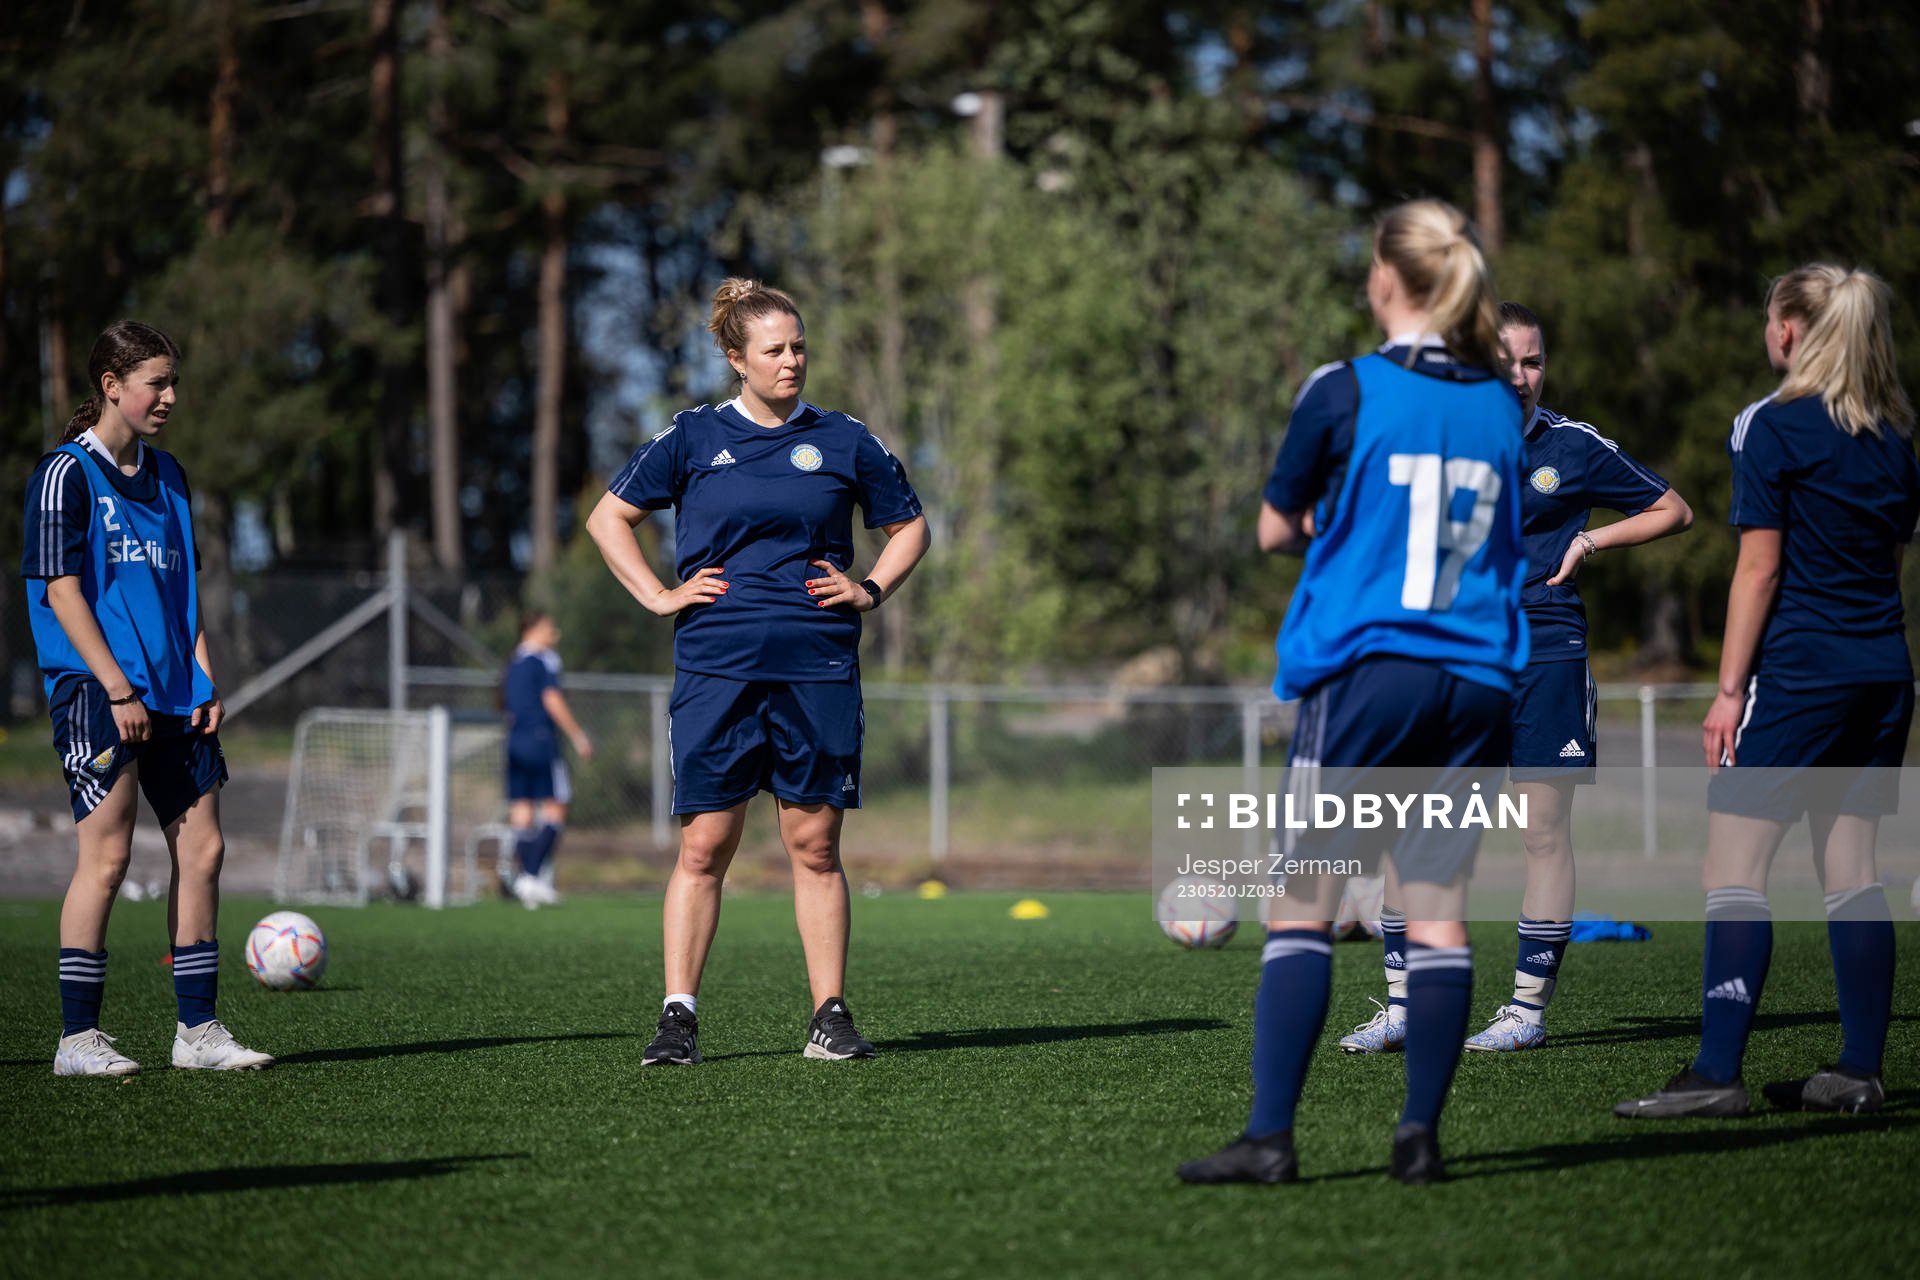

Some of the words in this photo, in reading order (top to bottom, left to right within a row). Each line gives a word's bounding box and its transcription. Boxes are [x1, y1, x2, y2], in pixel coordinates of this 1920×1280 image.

[711, 457, 736, 467] adidas
[1388, 453, 1502, 611] 19
[1559, 749, 1586, 757] adidas
